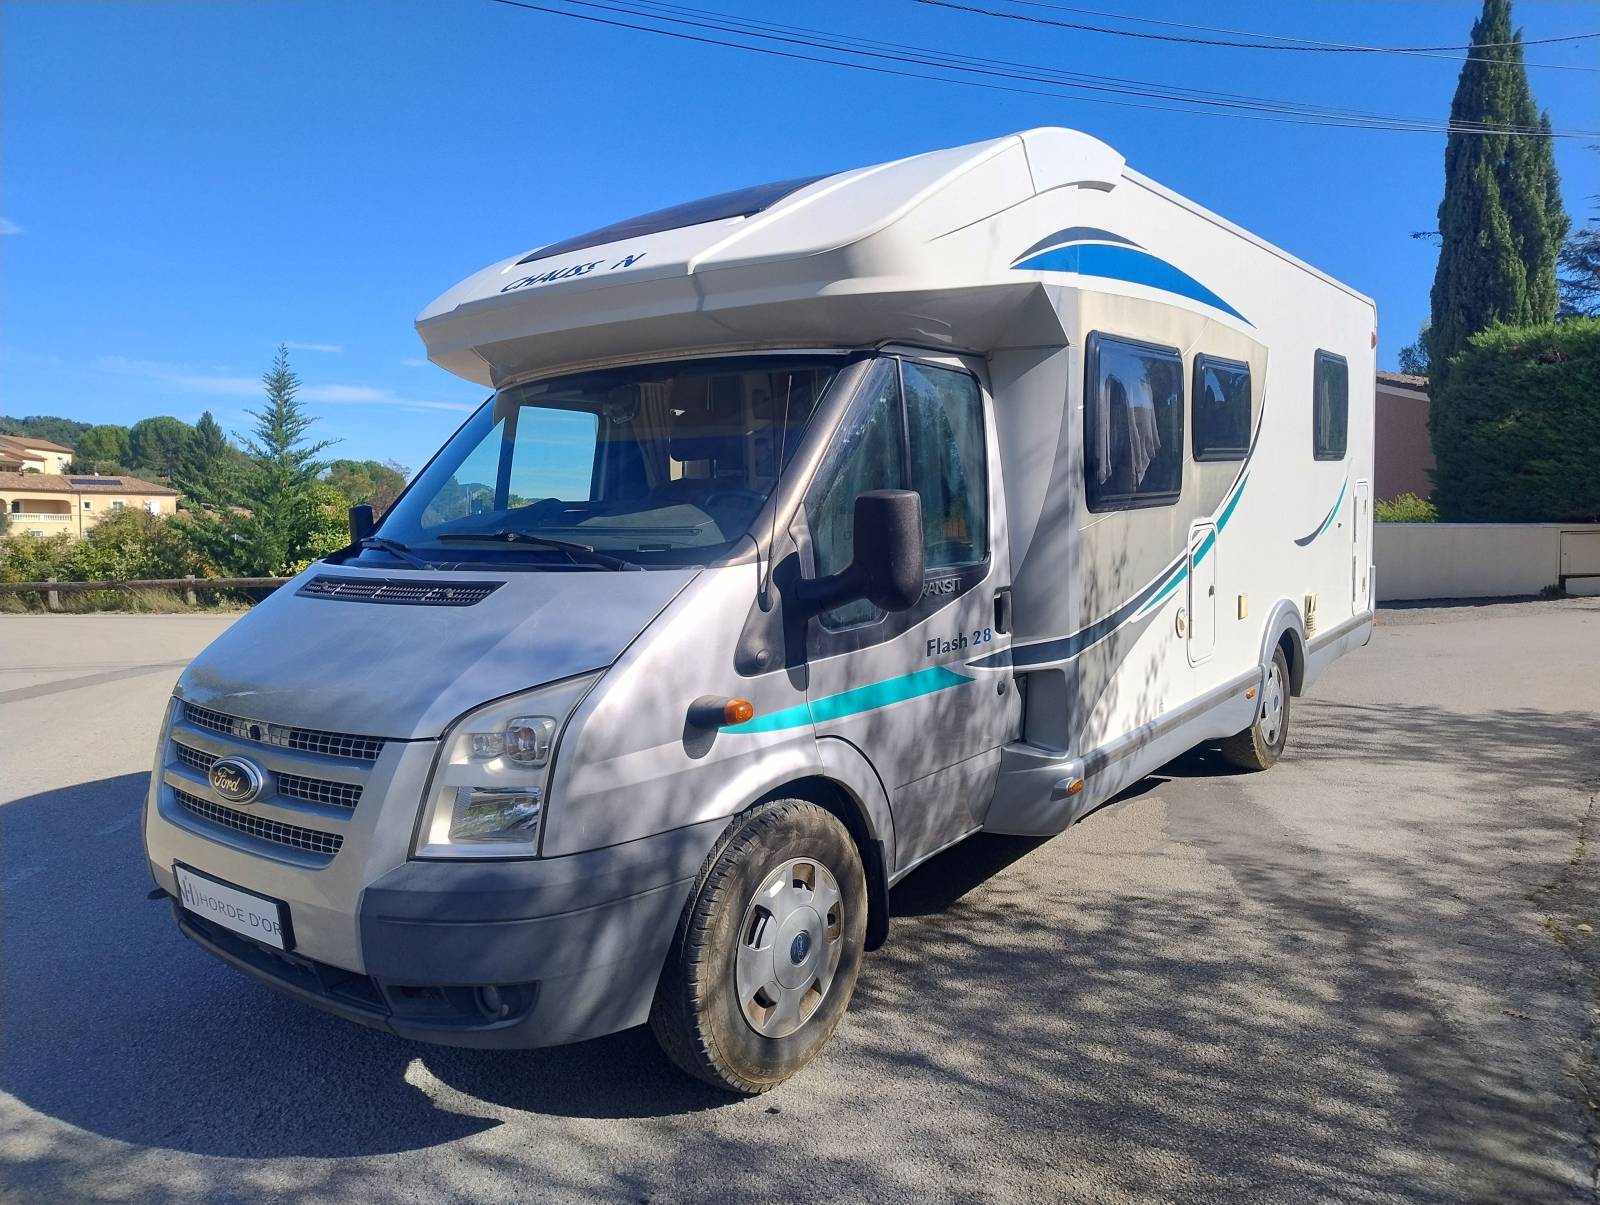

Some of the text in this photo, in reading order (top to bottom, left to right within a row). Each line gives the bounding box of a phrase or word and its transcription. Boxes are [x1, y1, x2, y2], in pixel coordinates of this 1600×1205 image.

[500, 252, 647, 293] CHAUSSN
[922, 578, 962, 597] RANSIT
[926, 627, 992, 657] Flash 28
[214, 766, 240, 792] Ford
[199, 893, 245, 922] HORDE
[248, 912, 282, 937] D'OR
